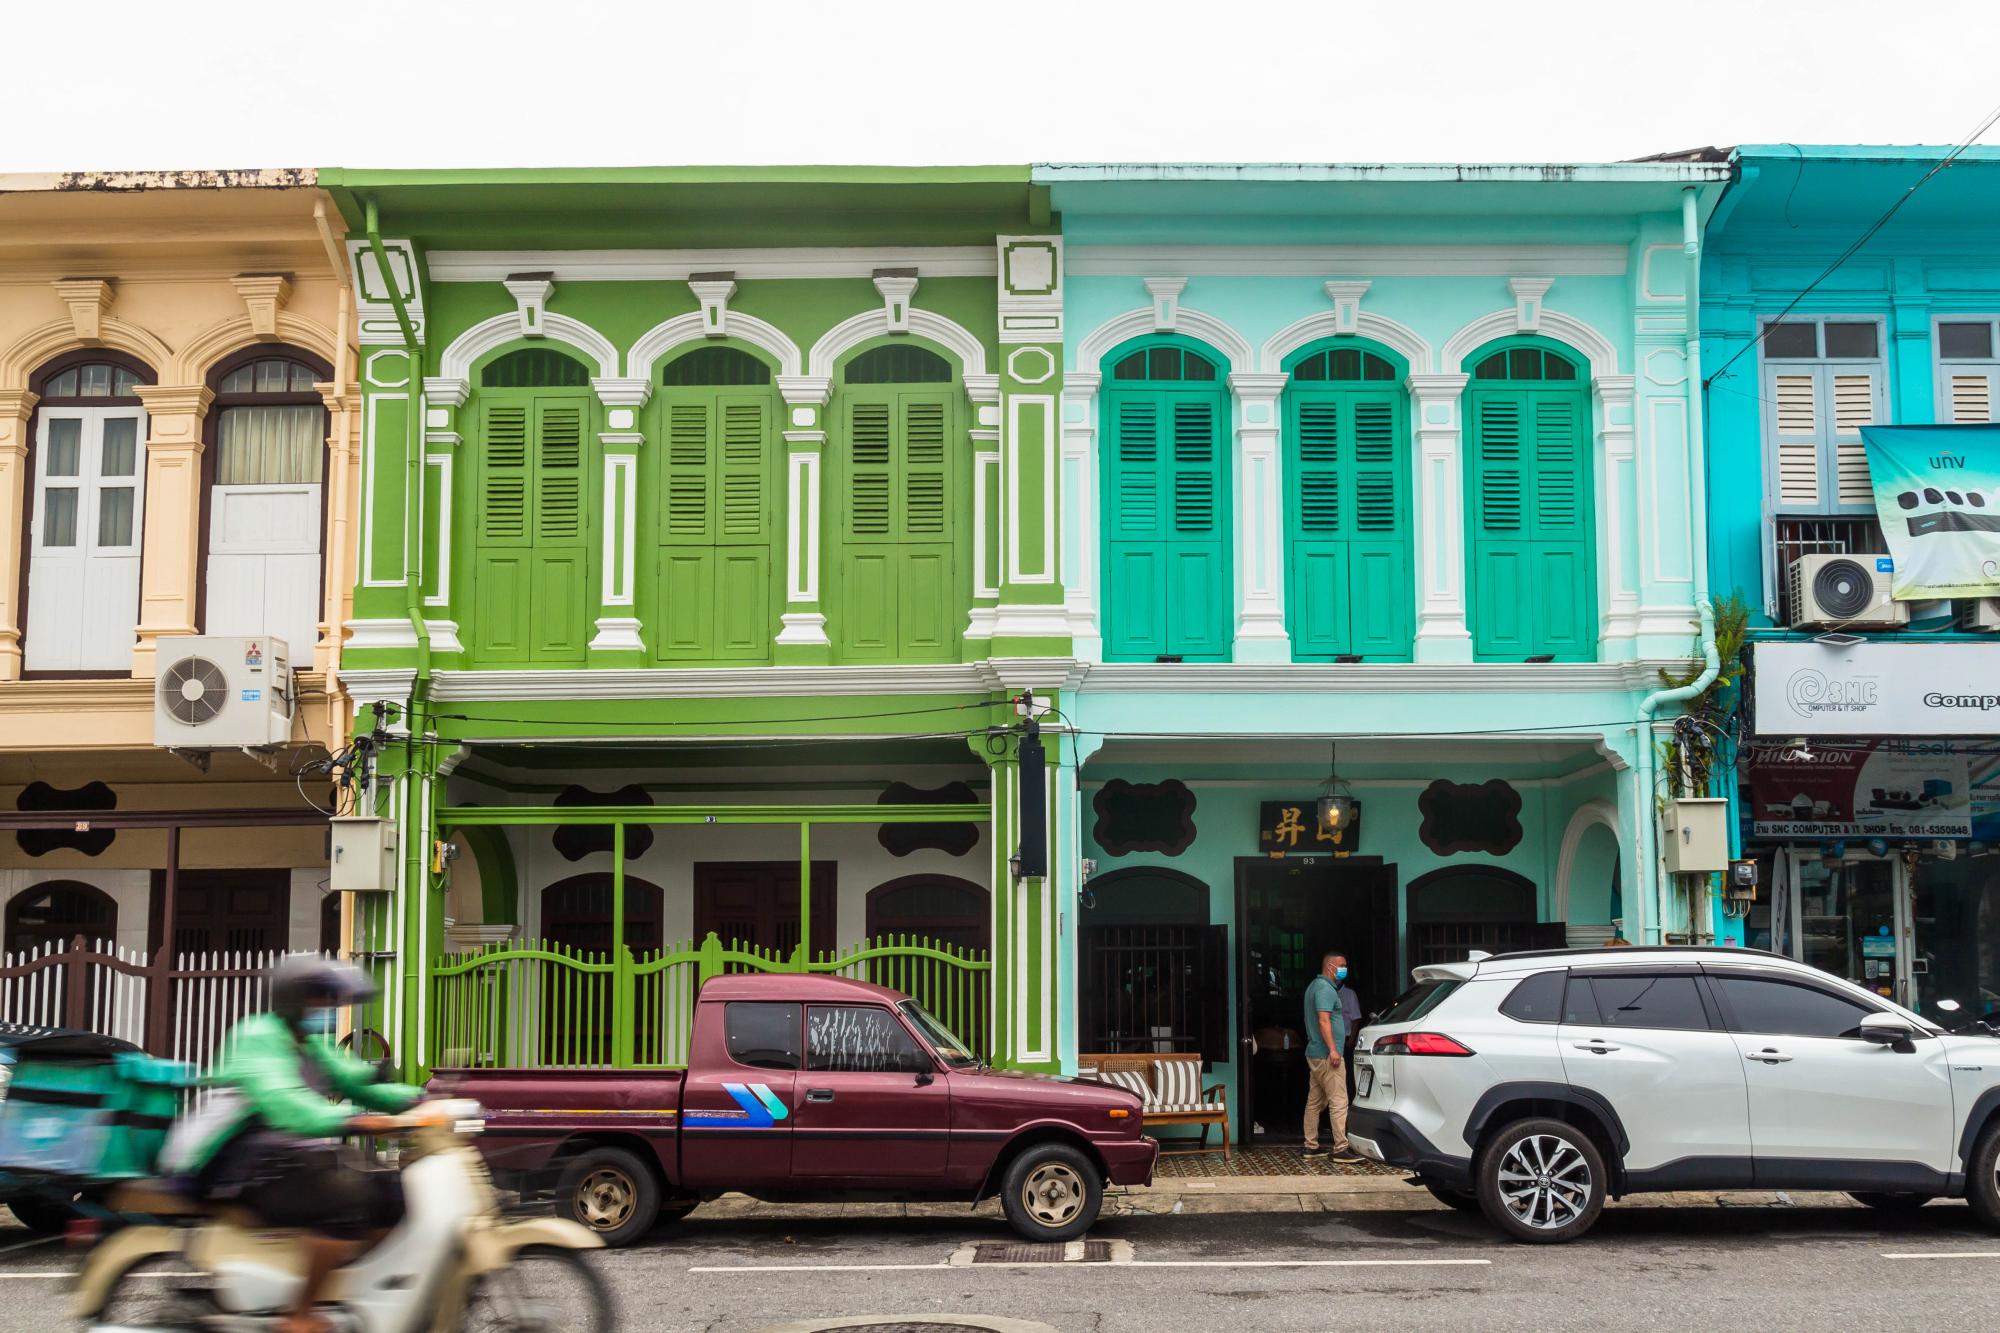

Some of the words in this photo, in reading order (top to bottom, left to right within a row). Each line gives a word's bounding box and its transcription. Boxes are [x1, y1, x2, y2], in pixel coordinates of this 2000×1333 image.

[1828, 681, 1877, 704] SNC
[1923, 692, 2000, 711] Comp
[1851, 704, 1867, 712] SHOP
[1771, 824, 1789, 834] SNC
[1792, 824, 1841, 835] COMPUTER
[1852, 825, 1860, 834] IT
[1863, 825, 1887, 834] SHOP
[1303, 857, 1315, 865] 93
